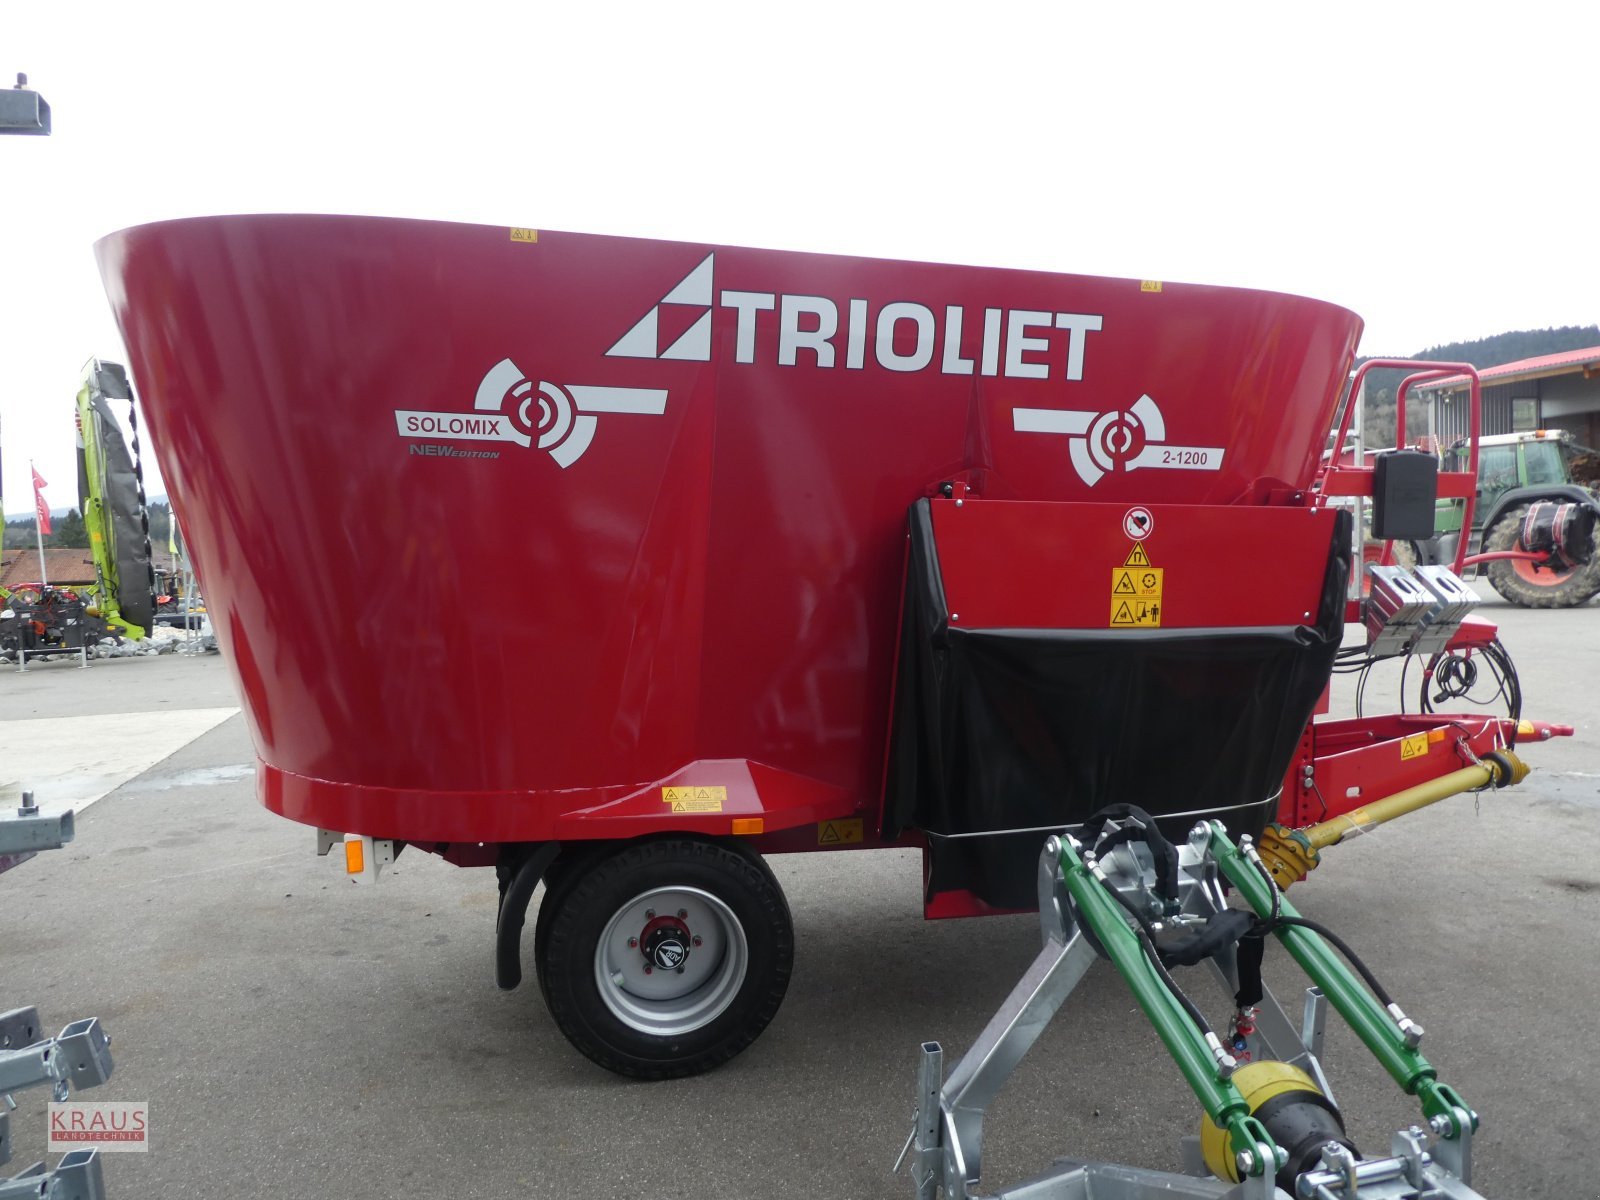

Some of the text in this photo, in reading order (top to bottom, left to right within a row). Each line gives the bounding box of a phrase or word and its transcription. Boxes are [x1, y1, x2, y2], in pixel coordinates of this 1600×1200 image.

[720, 289, 1104, 382] TRIOLIET
[406, 416, 501, 436] SOLOMIX
[1162, 450, 1208, 466] 2-1200
